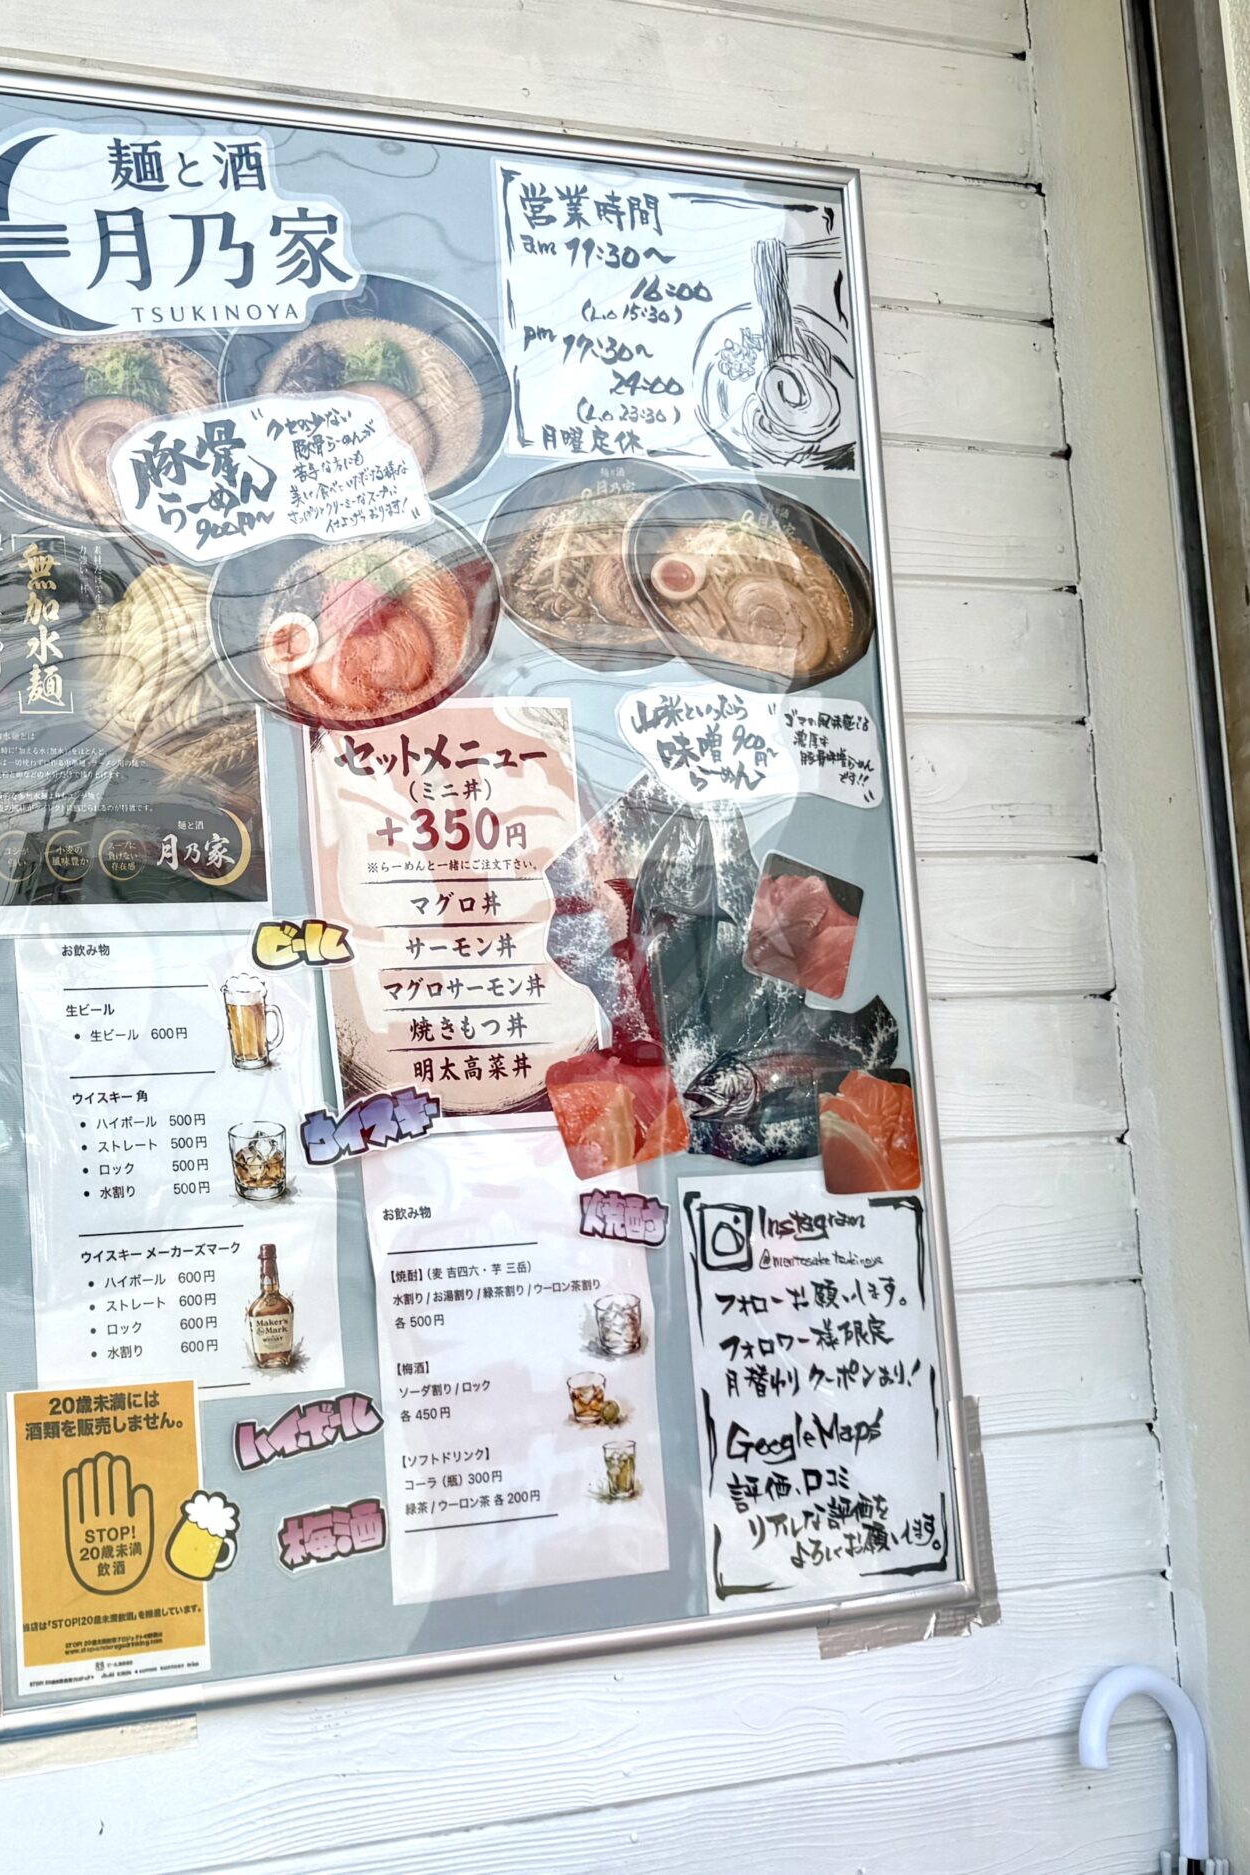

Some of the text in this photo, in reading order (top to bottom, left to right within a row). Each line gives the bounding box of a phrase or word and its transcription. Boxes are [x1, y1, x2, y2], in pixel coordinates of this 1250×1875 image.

[107, 137, 268, 192] 麺と酒
[519, 183, 664, 236] 営業時間
[87, 206, 353, 291] 月乃家
[520, 235, 557, 257] am
[131, 303, 299, 324] TSUKINOYA
[523, 325, 558, 351] pm
[541, 424, 645, 455] 月曜定休
[131, 419, 247, 509] 豚骨
[18, 543, 66, 707] 無加水麺
[334, 733, 548, 777] セットメニュー
[656, 722, 723, 770] 味噌
[409, 778, 492, 802] （ミニ丼）
[177, 820, 204, 831] 麺と酒
[376, 807, 527, 851] +350円
[156, 832, 236, 871] 月乃家
[367, 858, 538, 874] ※らーめんと一緒にご注文下さい。
[410, 891, 502, 917] マグロ丼
[61, 943, 110, 957] お飲み物
[406, 933, 517, 960] サーモン丼
[383, 973, 546, 1000] マグロサーモン丼
[66, 1003, 115, 1018] 生ビール
[90, 1027, 188, 1043] 生ビール 600円
[410, 1012, 528, 1042] 焼きもつ丼
[413, 1052, 532, 1083] 明太高菜丼
[71, 1090, 149, 1105] ウイスキー 角
[96, 1113, 206, 1130] ハイボール 500円
[98, 1136, 208, 1153] ストレート 500円
[98, 1159, 209, 1176] ロック 500円
[99, 1181, 210, 1199] 水割り 500円
[382, 1206, 432, 1221] お飲み物
[758, 1205, 866, 1241] Instagram
[80, 1241, 241, 1264] ウイスキー メーカーズマーク
[104, 1270, 216, 1288] ハイボール 600円
[106, 1293, 216, 1312] ストレート 600円
[392, 1278, 600, 1306] 水割り お湯割り 緑茶割り ウーロン茶割り
[715, 1276, 907, 1316] フォローお願いします。
[107, 1317, 217, 1335] ロック 600円
[395, 1314, 445, 1329] 各 500円
[107, 1339, 218, 1359] 水割り 600円
[719, 1313, 895, 1362] フォロワー様限定
[396, 1361, 430, 1376] 【梅酒】
[399, 1380, 491, 1398] ソーダ割り ロック
[49, 1390, 160, 1416] 20歳未満には
[400, 1407, 451, 1422] 各 450円
[25, 1412, 183, 1441] 酒類を販売しません。
[726, 1411, 817, 1465] Google
[402, 1448, 490, 1468] 【ソフトドリンク】
[405, 1470, 502, 1490] コーラ 300円
[405, 1489, 541, 1515] 緑茶 ウーロン茶 各 200円
[748, 1493, 889, 1549] リアルな評価を
[84, 1525, 136, 1544] STOP!
[79, 1543, 143, 1561] 20歳未満
[97, 1561, 126, 1577] 飲酒
